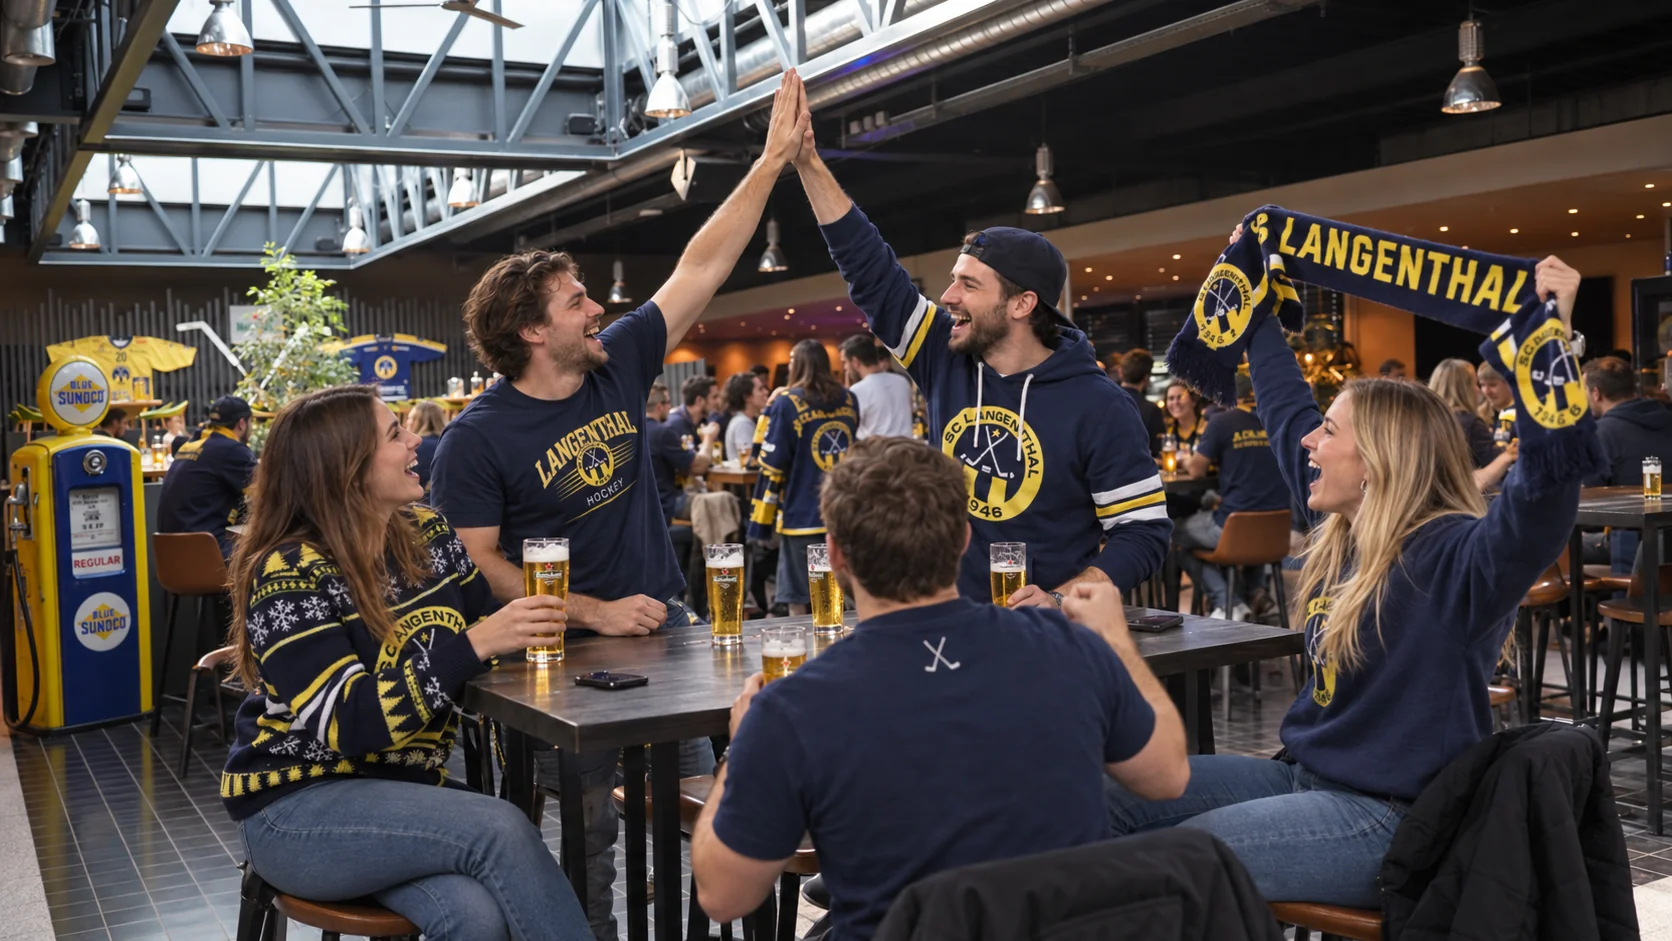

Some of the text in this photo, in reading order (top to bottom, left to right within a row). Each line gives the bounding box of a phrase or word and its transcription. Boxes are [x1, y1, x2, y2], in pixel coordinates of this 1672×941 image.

[1279, 216, 1528, 314] LANGENTHAL
[70, 380, 93, 390] BLUE
[58, 390, 105, 405] SUNOCO
[944, 422, 962, 444] SC
[535, 411, 638, 490] LANGENTHAL
[586, 477, 624, 506] HOCKEY
[968, 495, 1003, 518] 946
[74, 555, 121, 569] REGULAR
[92, 608, 114, 620] BLUE
[81, 616, 126, 635] SUNOCO
[393, 610, 463, 643] ANGENTH
